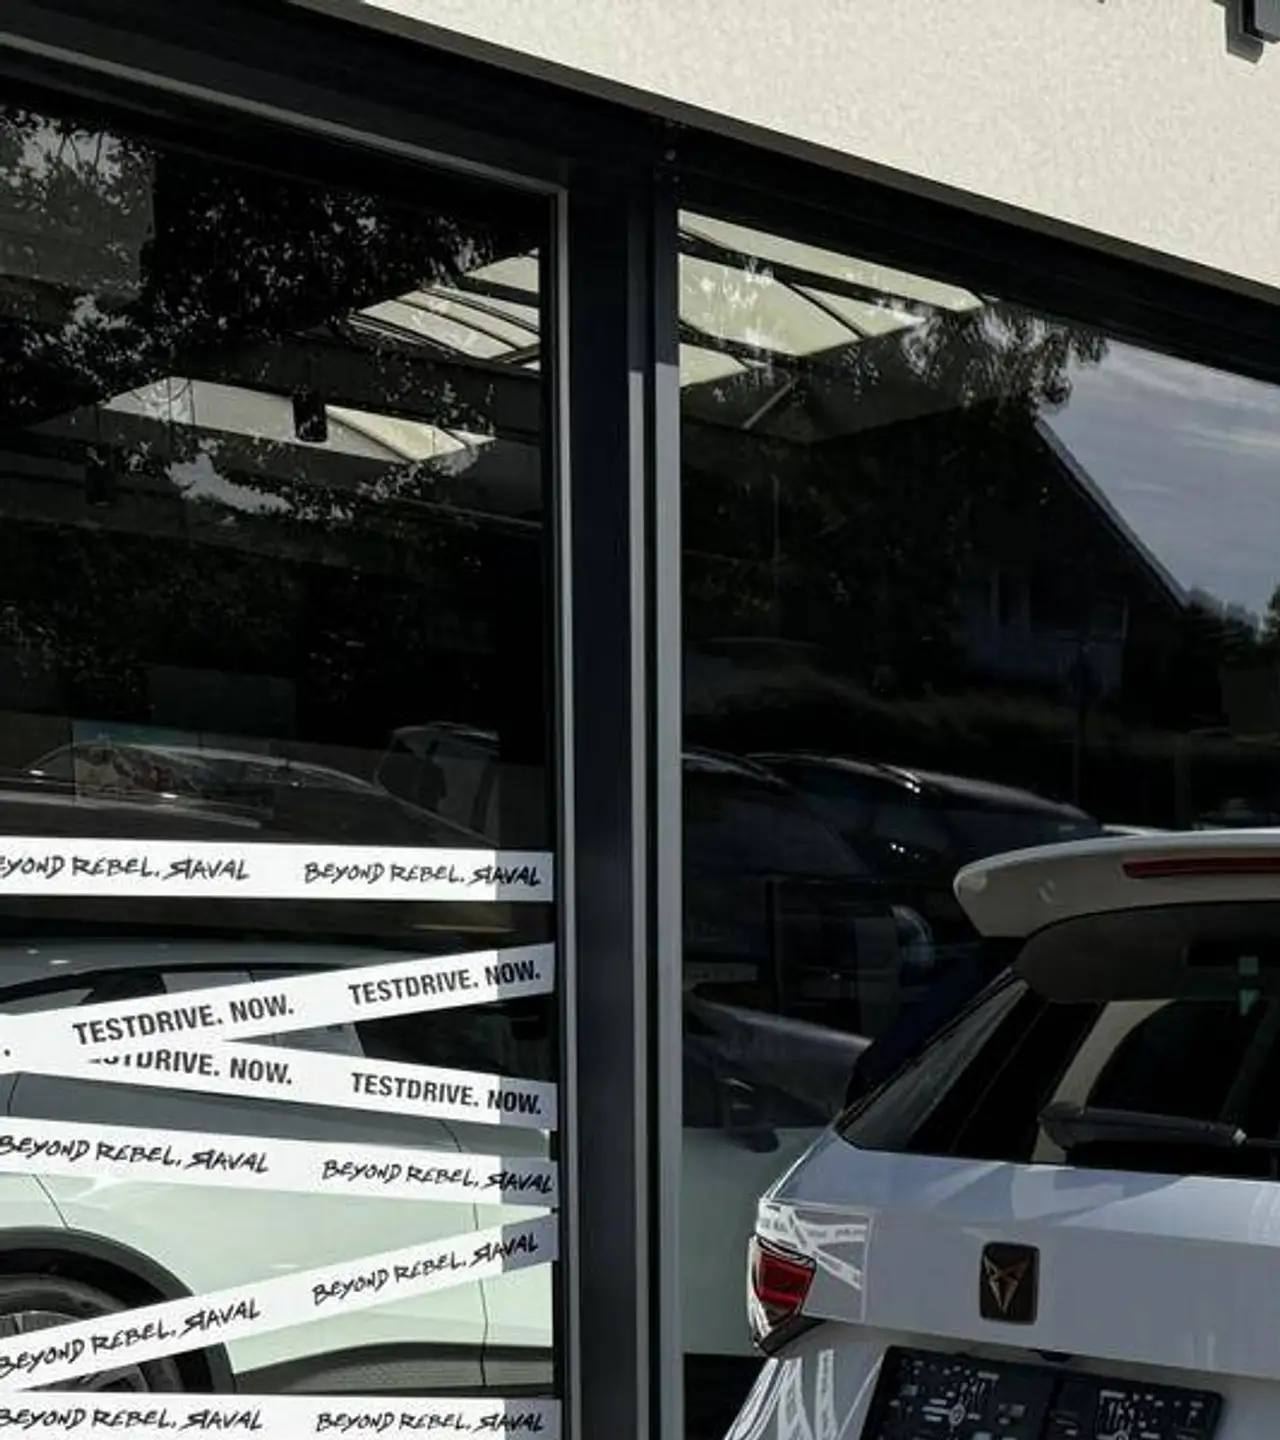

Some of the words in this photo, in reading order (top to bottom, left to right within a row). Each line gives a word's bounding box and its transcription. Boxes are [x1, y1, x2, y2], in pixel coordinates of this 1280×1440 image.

[0, 855, 65, 880] EYOND
[304, 862, 385, 884] BEYOND
[348, 968, 479, 1006] TESTDRIVE.
[484, 959, 542, 985] NOW.
[72, 1004, 223, 1045] TESTDRIVE.
[229, 993, 295, 1023] NOW.
[229, 1057, 293, 1085] NOW.
[351, 1072, 480, 1107] TESTDRIVE.
[487, 1090, 542, 1115] NOW.
[322, 1159, 401, 1184] BEYOND
[312, 1269, 390, 1306] BEYOND
[316, 1412, 394, 1433] BEYOND
